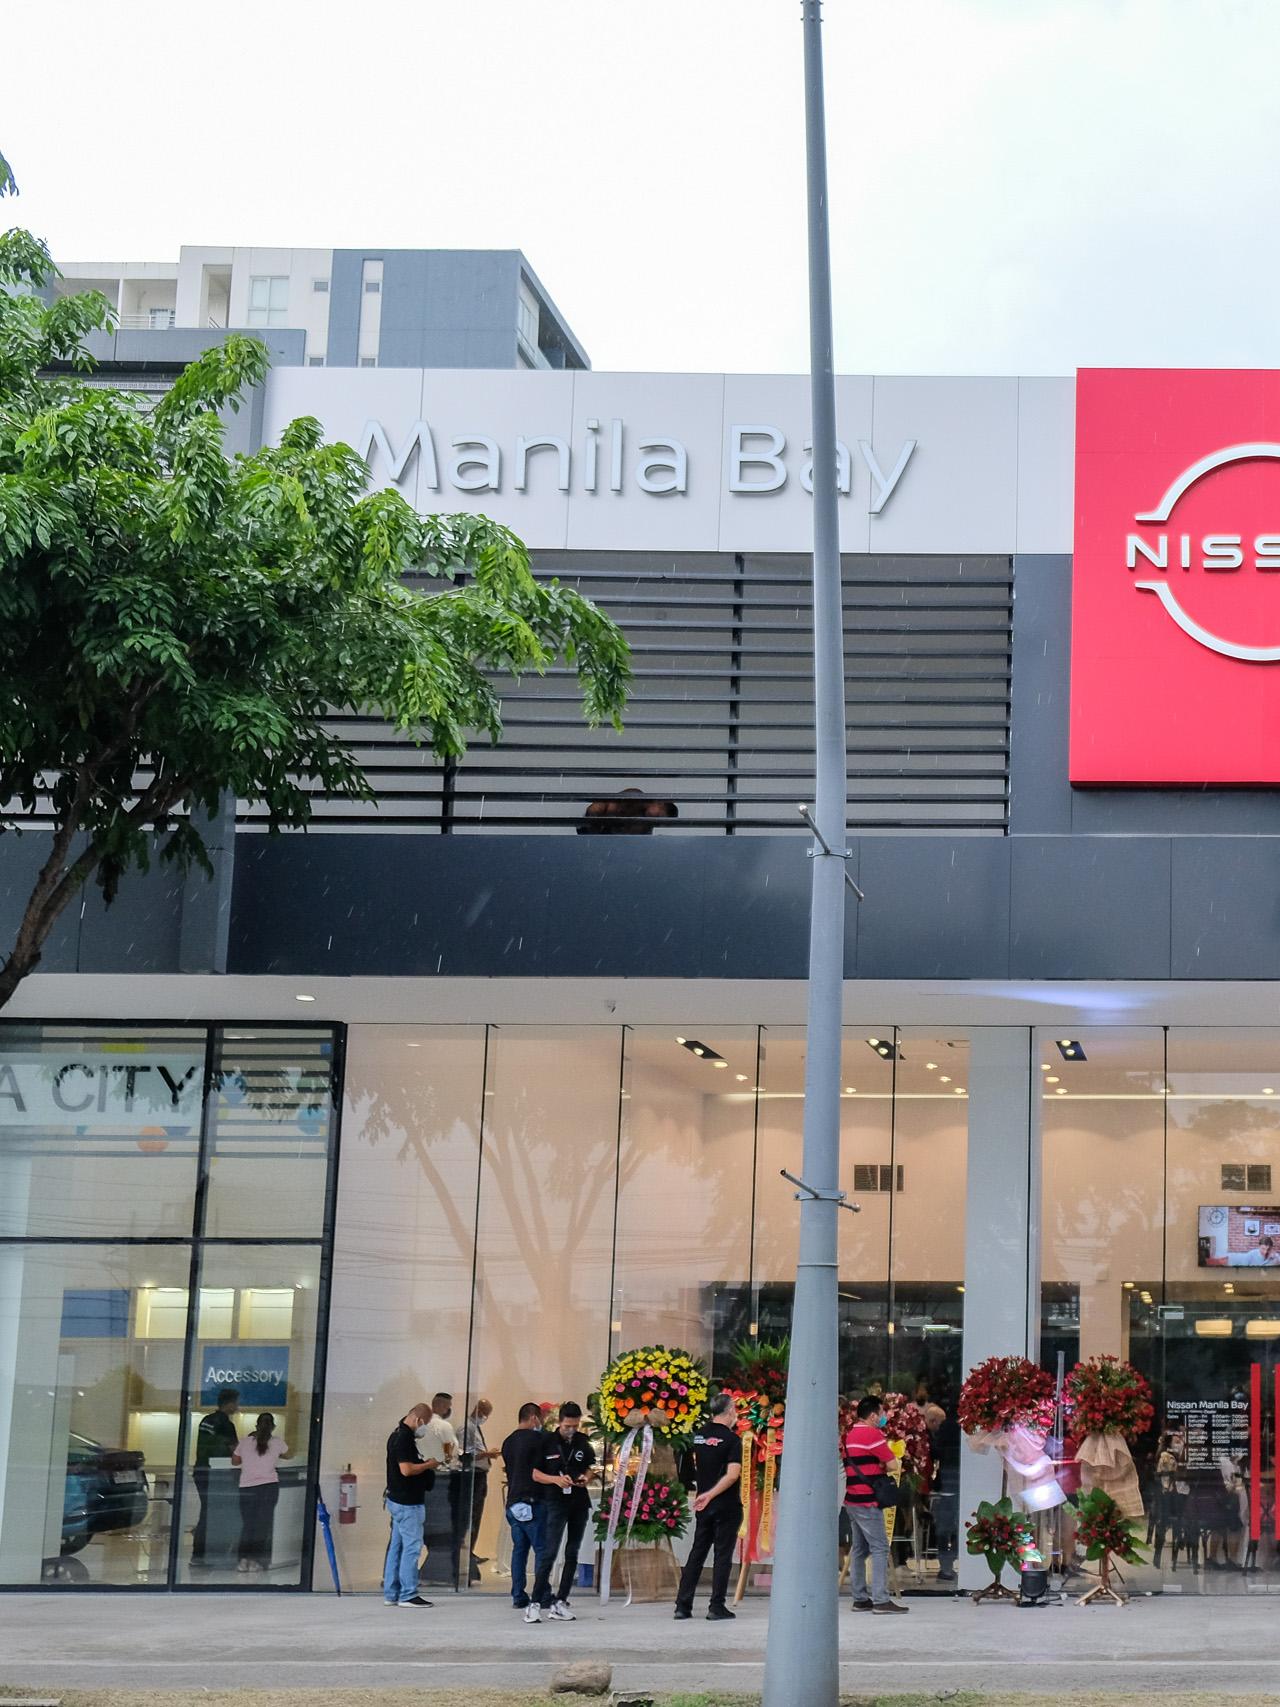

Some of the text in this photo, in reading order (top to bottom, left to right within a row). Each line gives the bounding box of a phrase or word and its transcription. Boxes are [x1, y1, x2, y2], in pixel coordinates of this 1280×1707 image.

[359, 418, 689, 493] Manila
[52, 1063, 197, 1113] CITY
[205, 1366, 284, 1386] Accessory
[1167, 1401, 1249, 1411] Nissan Manila Bay
